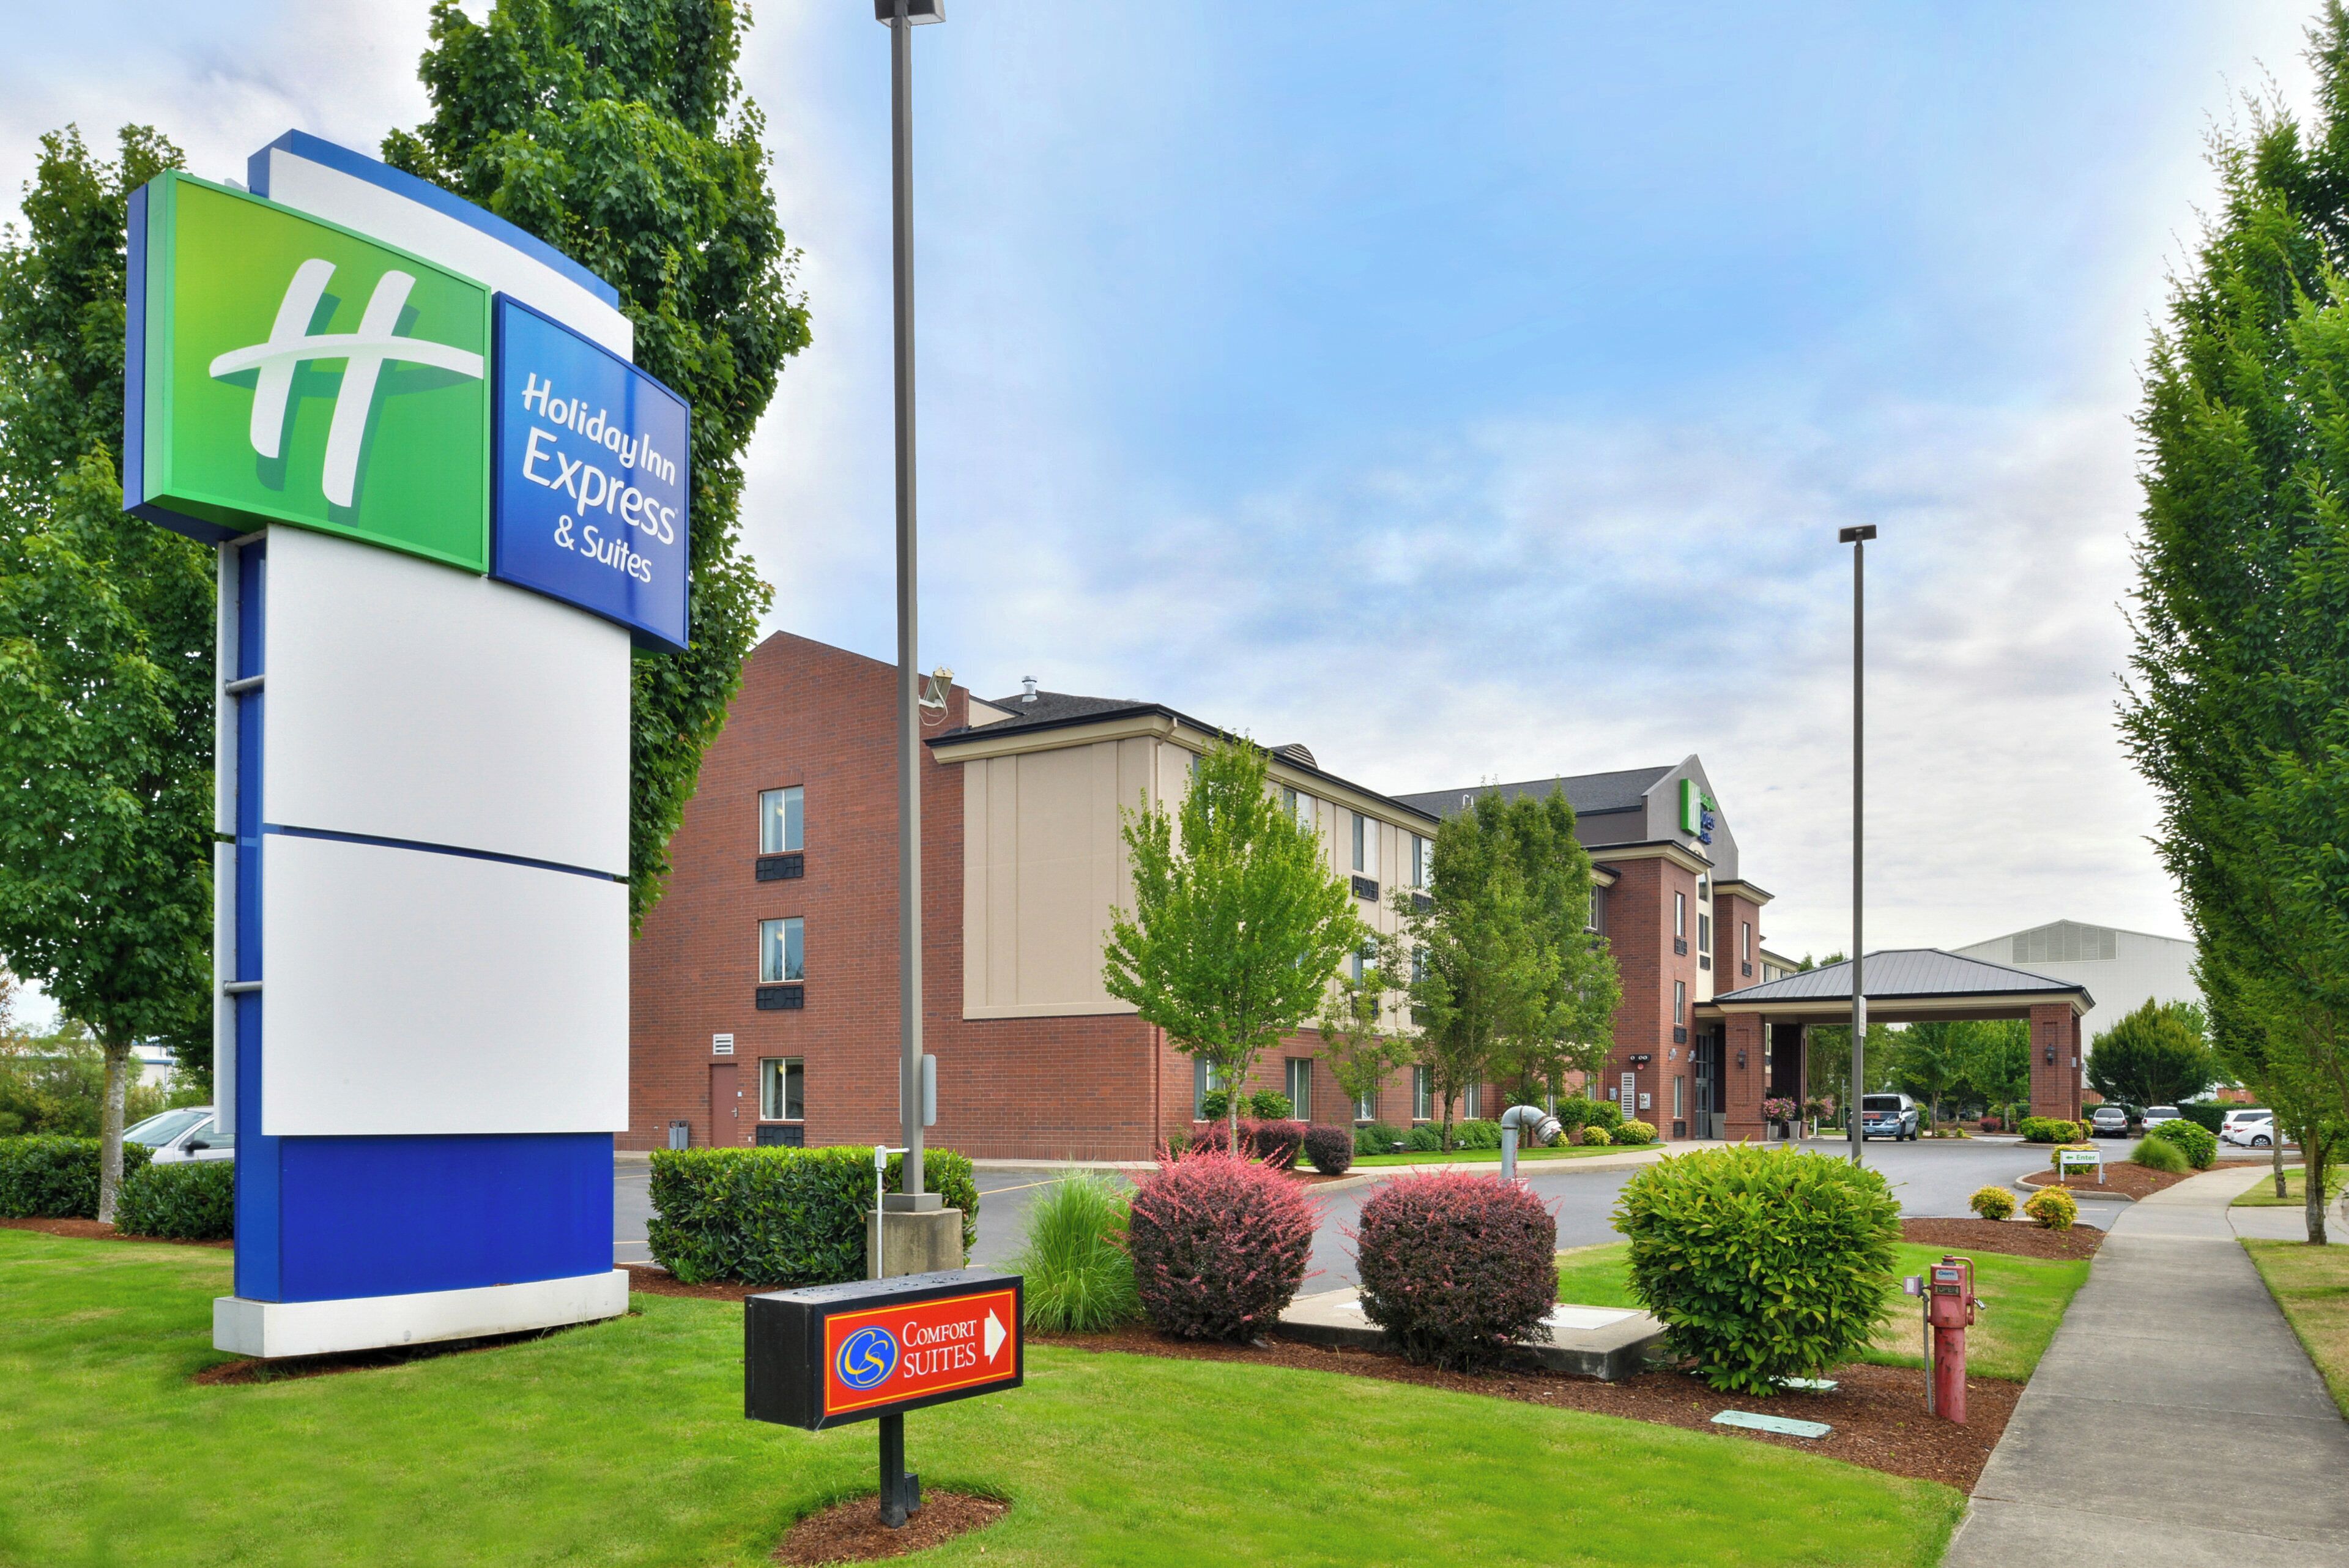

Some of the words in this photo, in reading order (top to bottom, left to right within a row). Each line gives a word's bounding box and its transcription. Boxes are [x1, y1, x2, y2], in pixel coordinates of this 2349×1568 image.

[522, 372, 637, 468] Holiday
[640, 433, 675, 486] Inn
[522, 426, 675, 545] Express
[554, 515, 574, 551] &
[581, 525, 652, 583] Suites
[902, 1320, 977, 1347] COMFORT
[904, 1342, 976, 1378] SUITES
